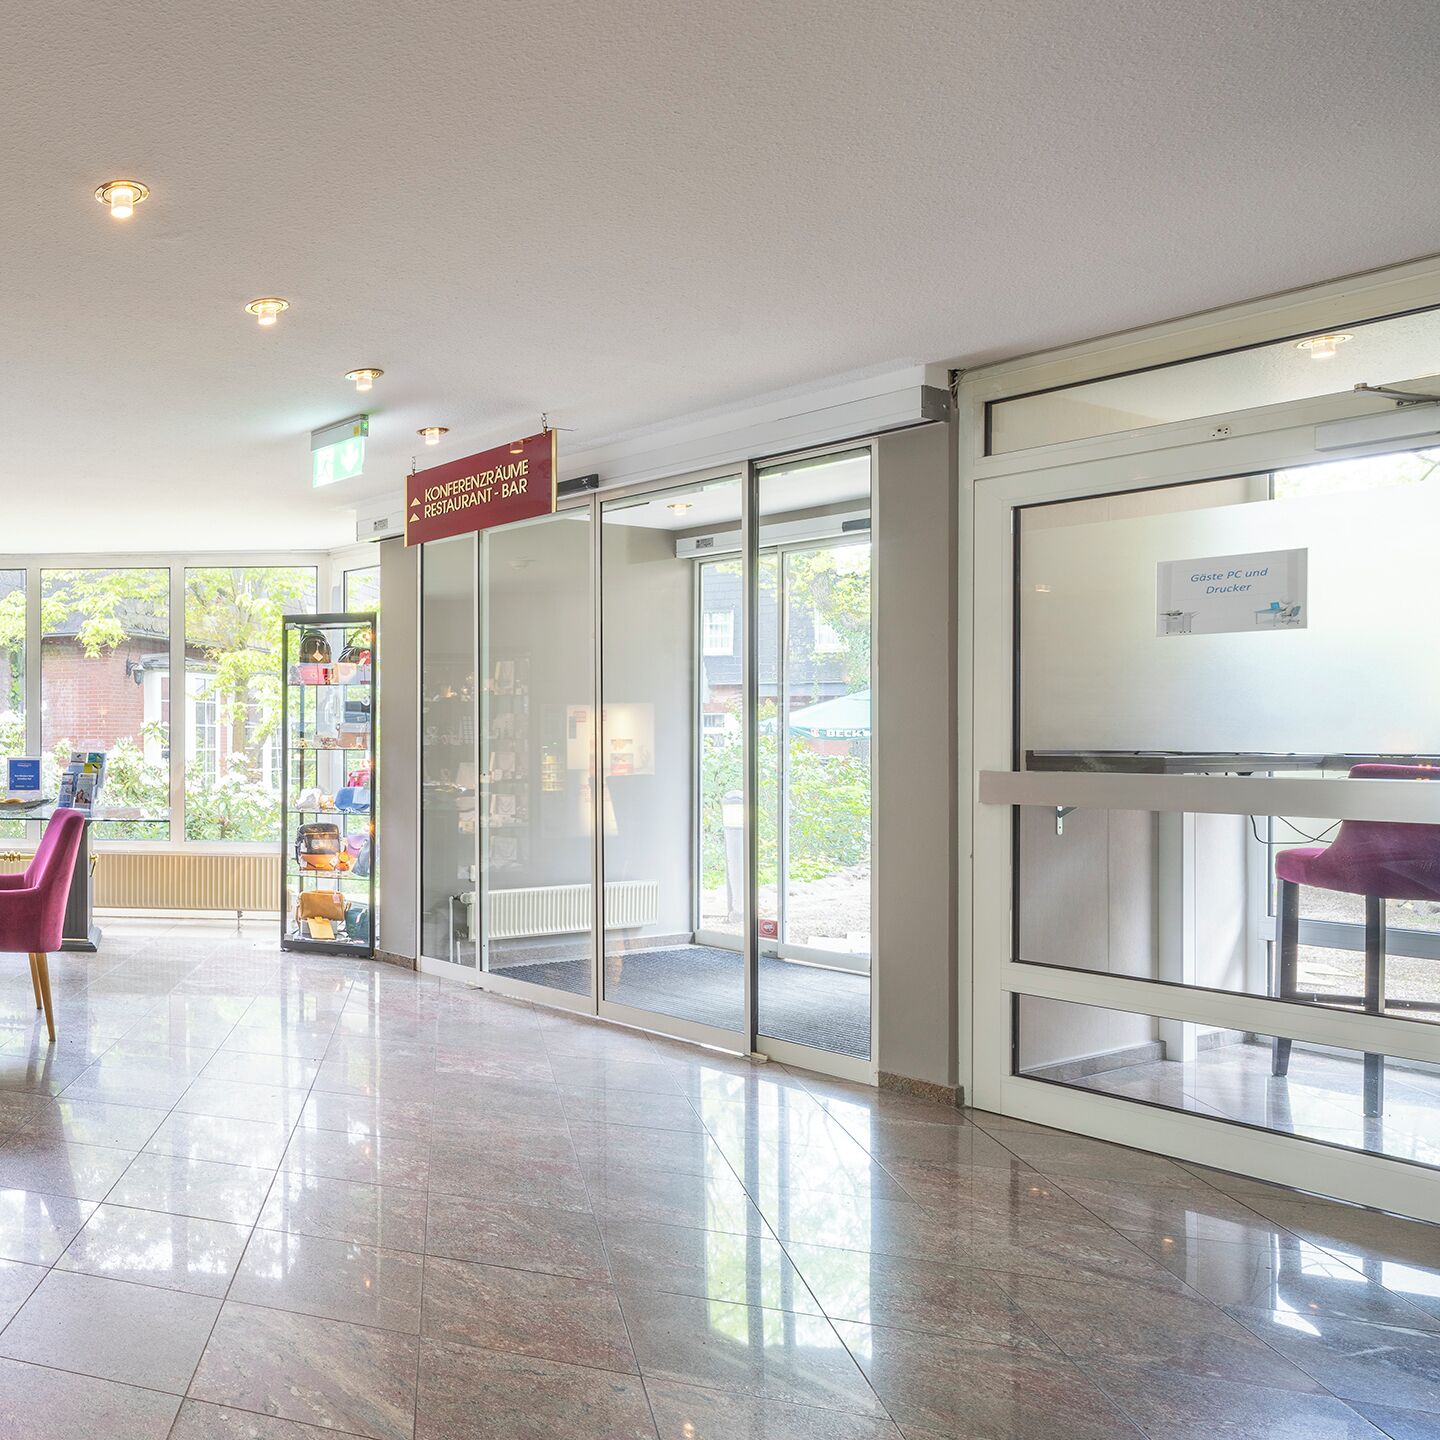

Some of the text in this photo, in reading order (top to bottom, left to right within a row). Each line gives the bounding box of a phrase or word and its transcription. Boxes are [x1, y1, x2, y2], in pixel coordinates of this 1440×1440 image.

[425, 459, 529, 502] KONFERENZRÄUME
[424, 487, 493, 518] RESTAURANT
[502, 478, 528, 498] BAR
[1190, 567, 1269, 583] Gäste PC und
[1206, 584, 1252, 595] Drucker
